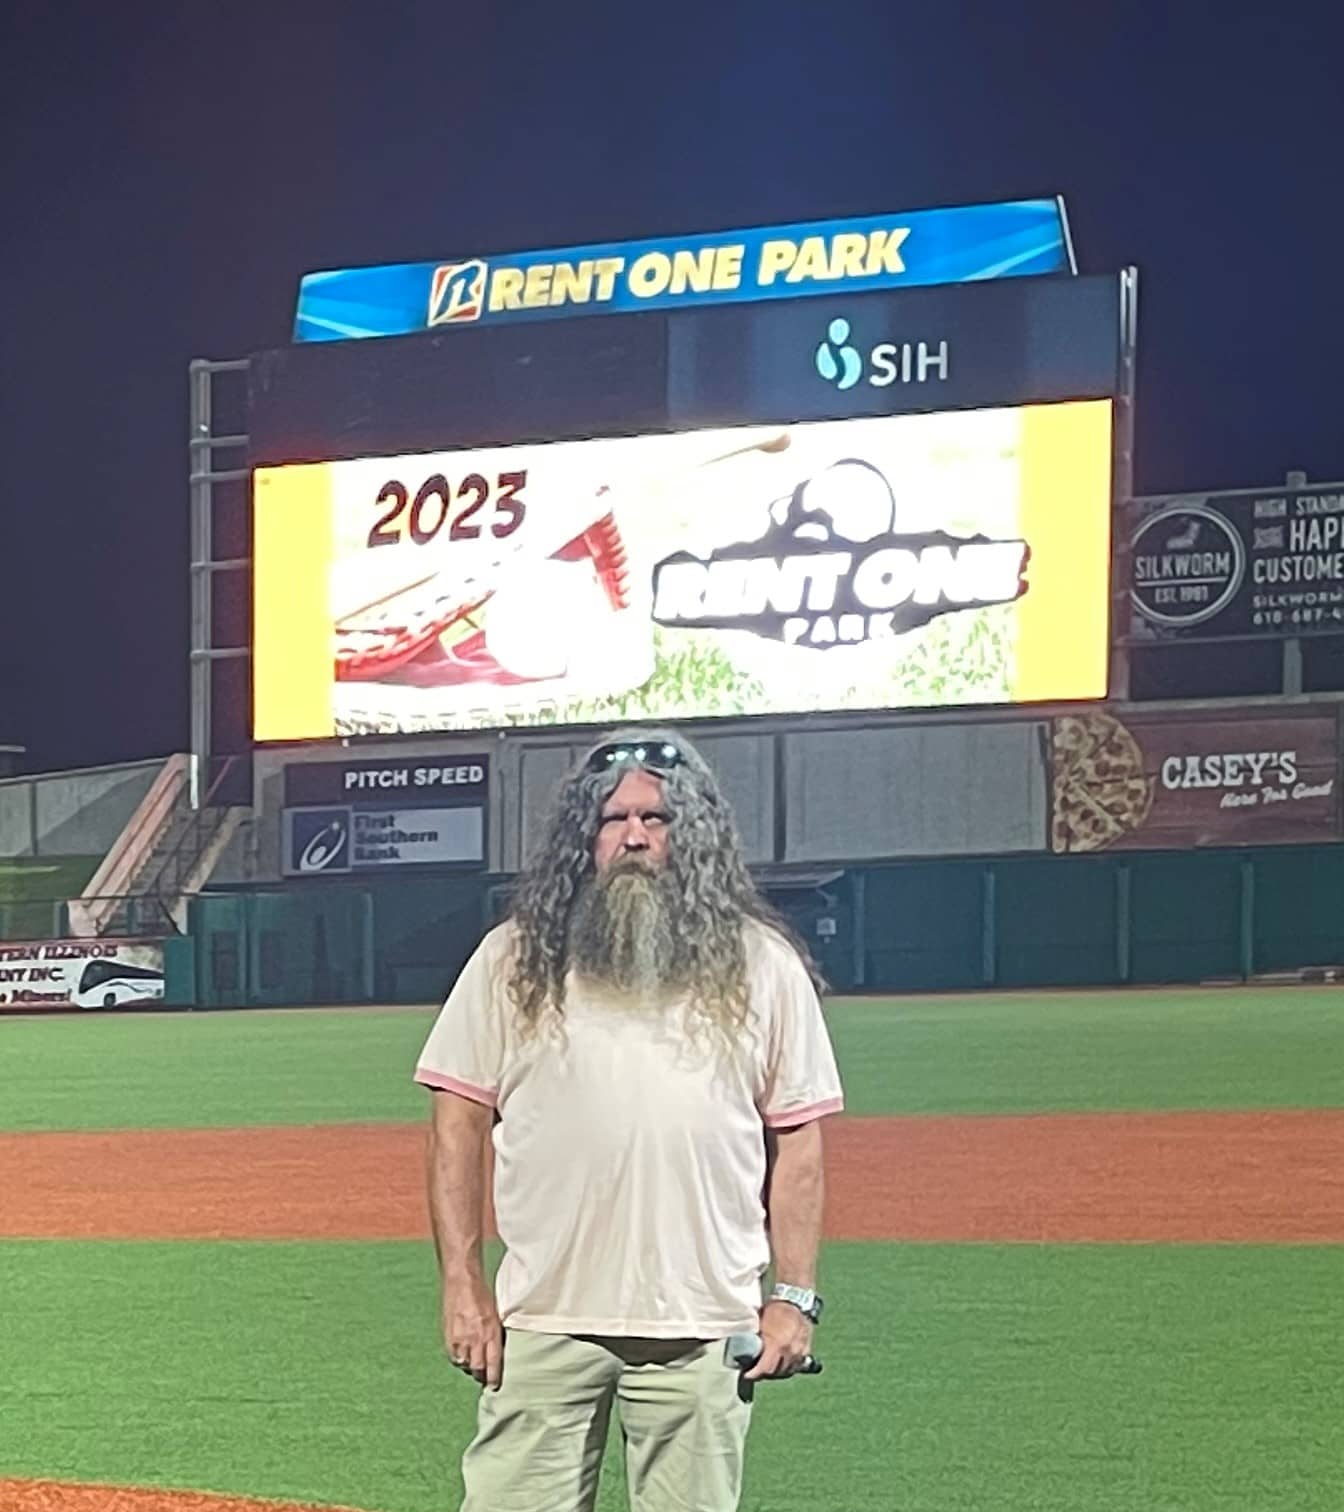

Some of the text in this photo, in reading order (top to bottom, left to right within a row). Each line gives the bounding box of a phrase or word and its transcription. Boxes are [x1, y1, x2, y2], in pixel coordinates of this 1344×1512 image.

[488, 228, 911, 312] RENT ONE PARK
[869, 341, 948, 387] SIH
[367, 469, 528, 548] 2023
[653, 541, 1026, 619] RENT ONE
[1136, 552, 1230, 579] SILKWORM
[783, 612, 896, 645] PARK
[345, 765, 484, 789] PITCH SPEED
[1162, 752, 1297, 789] CASEY'S
[354, 814, 395, 830] First
[354, 829, 439, 845] Southern
[354, 846, 400, 861] Bank
